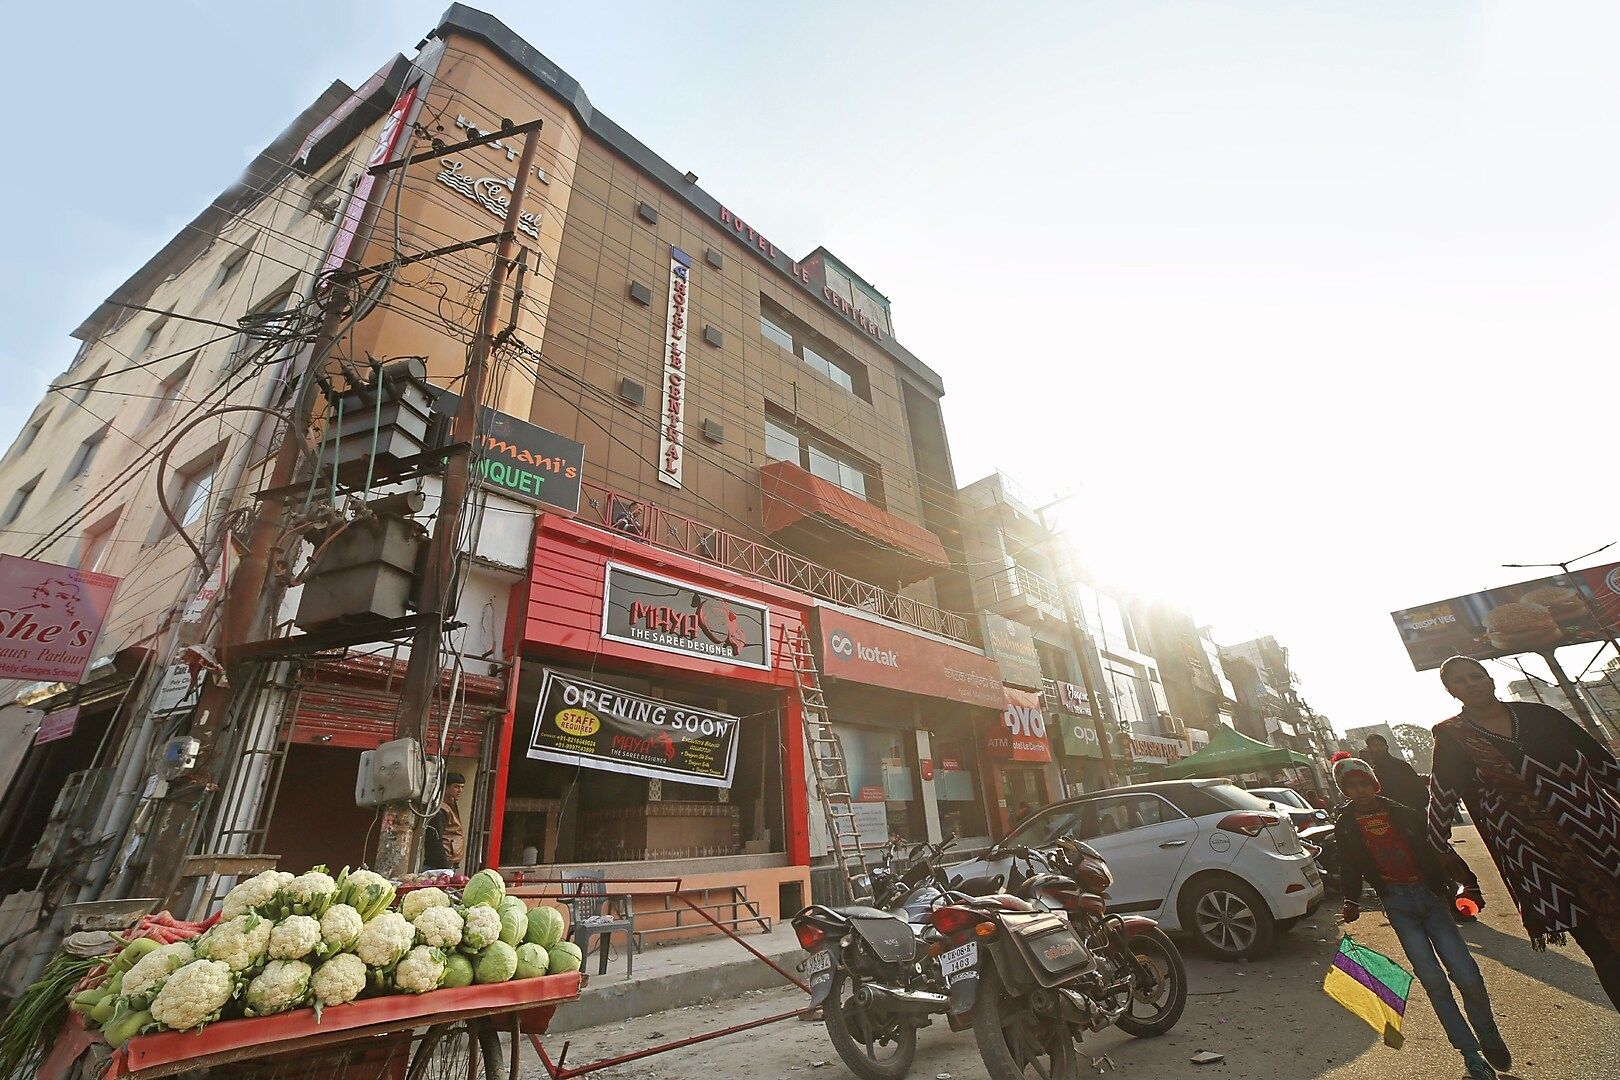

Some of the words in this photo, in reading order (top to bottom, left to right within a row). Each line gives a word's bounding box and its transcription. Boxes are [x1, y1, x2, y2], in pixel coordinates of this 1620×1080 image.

[719, 204, 776, 259] HOTEL
[791, 261, 810, 284] LE
[822, 285, 883, 341] CENTRAL
[671, 280, 687, 340] HOTEL
[670, 342, 683, 369] LE
[665, 373, 682, 475] CENTRAL
[629, 600, 700, 641] MAYA
[1412, 618, 1438, 630] CRISPY
[1438, 614, 1456, 625] VEG
[630, 627, 650, 640] THE
[652, 632, 685, 647] SAREE
[687, 639, 734, 657] DESIGNER
[857, 642, 899, 667] kotak
[37, 648, 87, 665] Parlour
[52, 667, 80, 678] School
[562, 712, 596, 726] STAFF
[563, 685, 667, 726] OPENING
[671, 711, 728, 738] SOON
[1004, 703, 1044, 738] OYO
[560, 721, 593, 733] REQUIRED
[611, 748, 621, 756] THE
[622, 750, 640, 760] SAREE
[640, 754, 667, 764] DESIGNER
[612, 734, 651, 754] MAYA
[988, 739, 1008, 748] ATM
